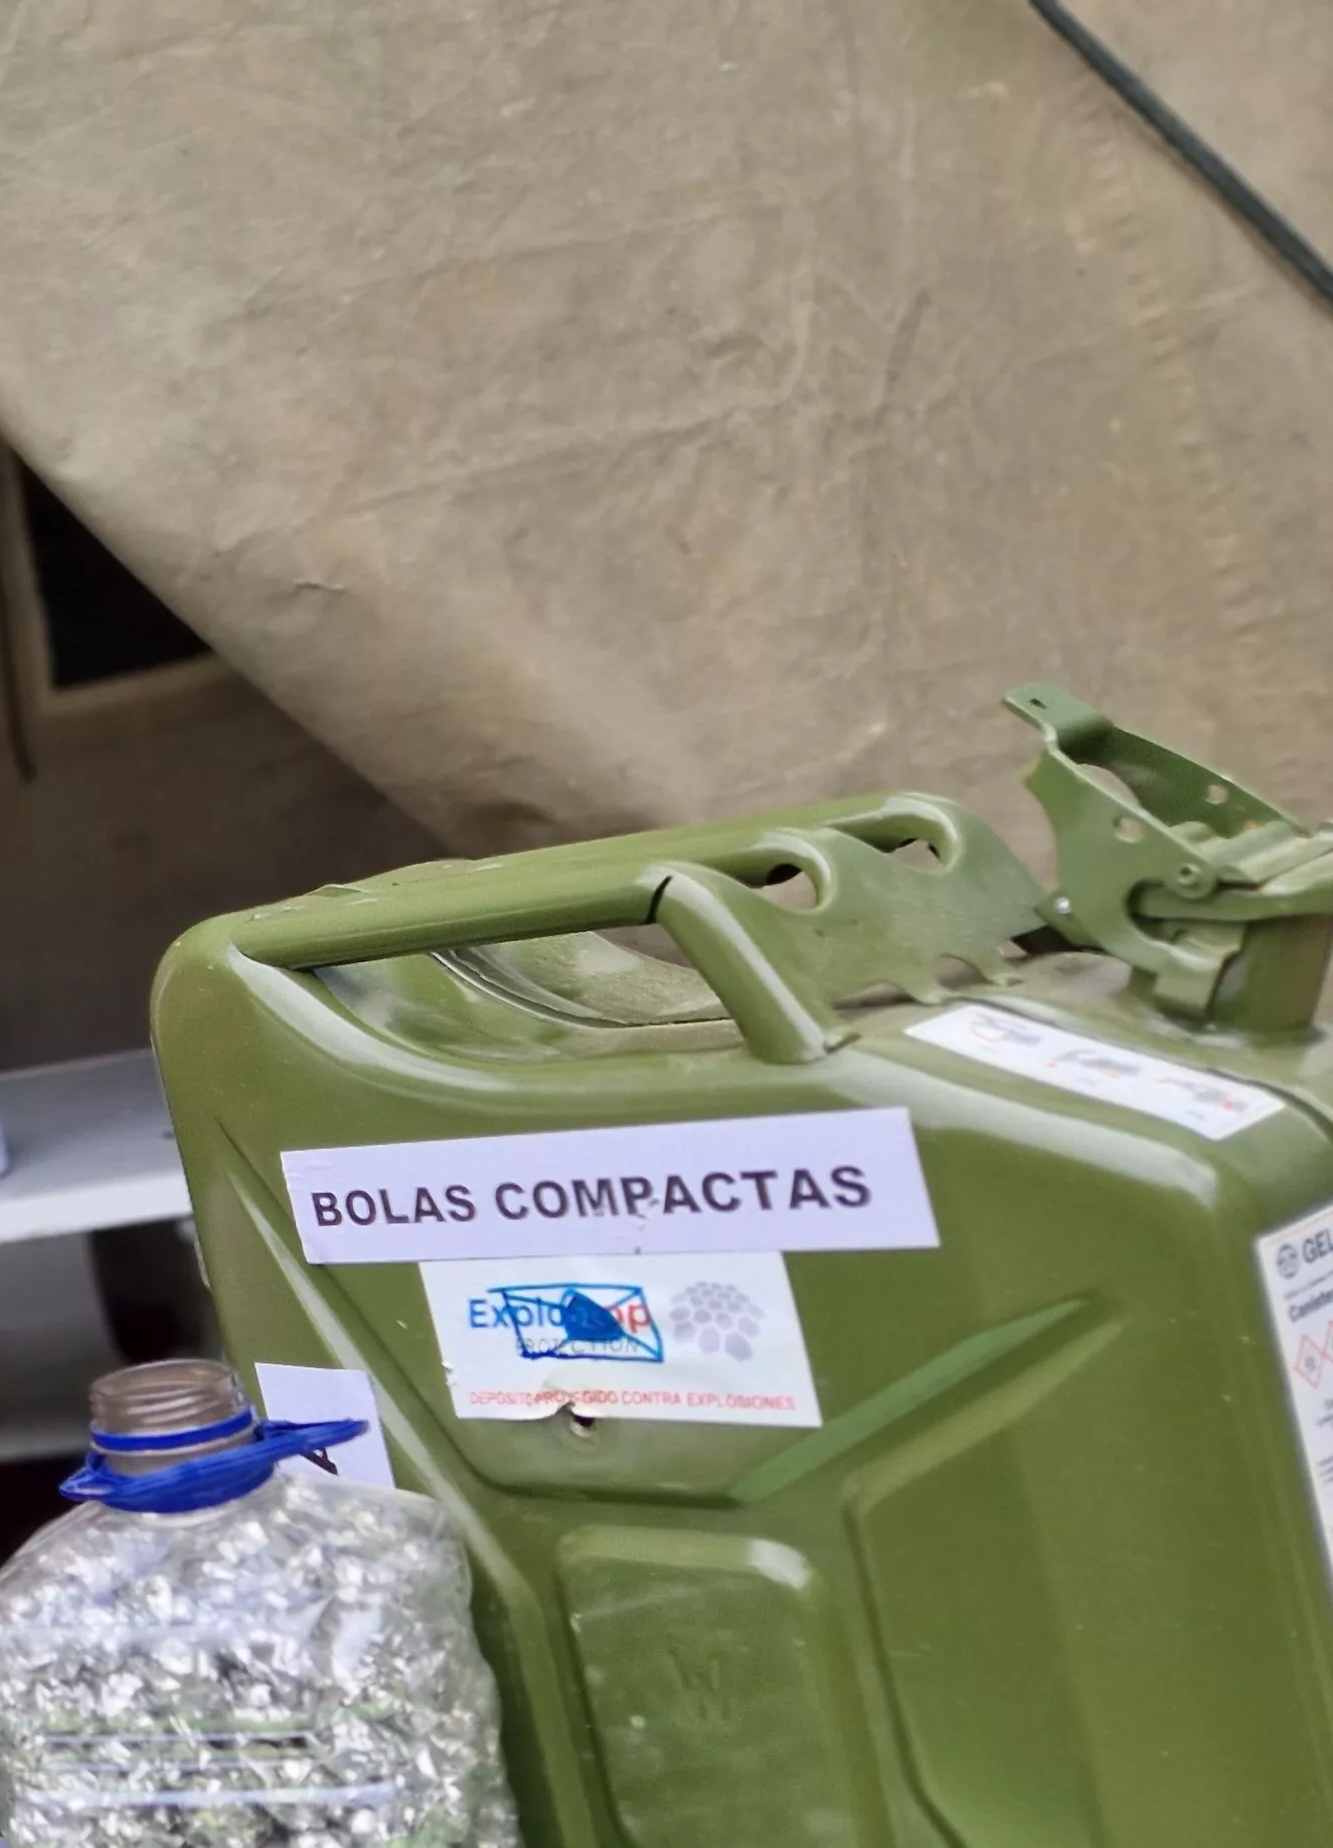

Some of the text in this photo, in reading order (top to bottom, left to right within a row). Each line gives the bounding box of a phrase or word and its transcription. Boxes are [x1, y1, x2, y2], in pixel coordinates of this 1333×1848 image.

[312, 1165, 871, 1227] BOLAS COMPACTAS
[468, 1297, 651, 1334] Exploop
[516, 1336, 638, 1354] PROTCTION
[621, 1391, 681, 1406] CONTRA
[686, 1392, 796, 1411] EXPLOSIONES
